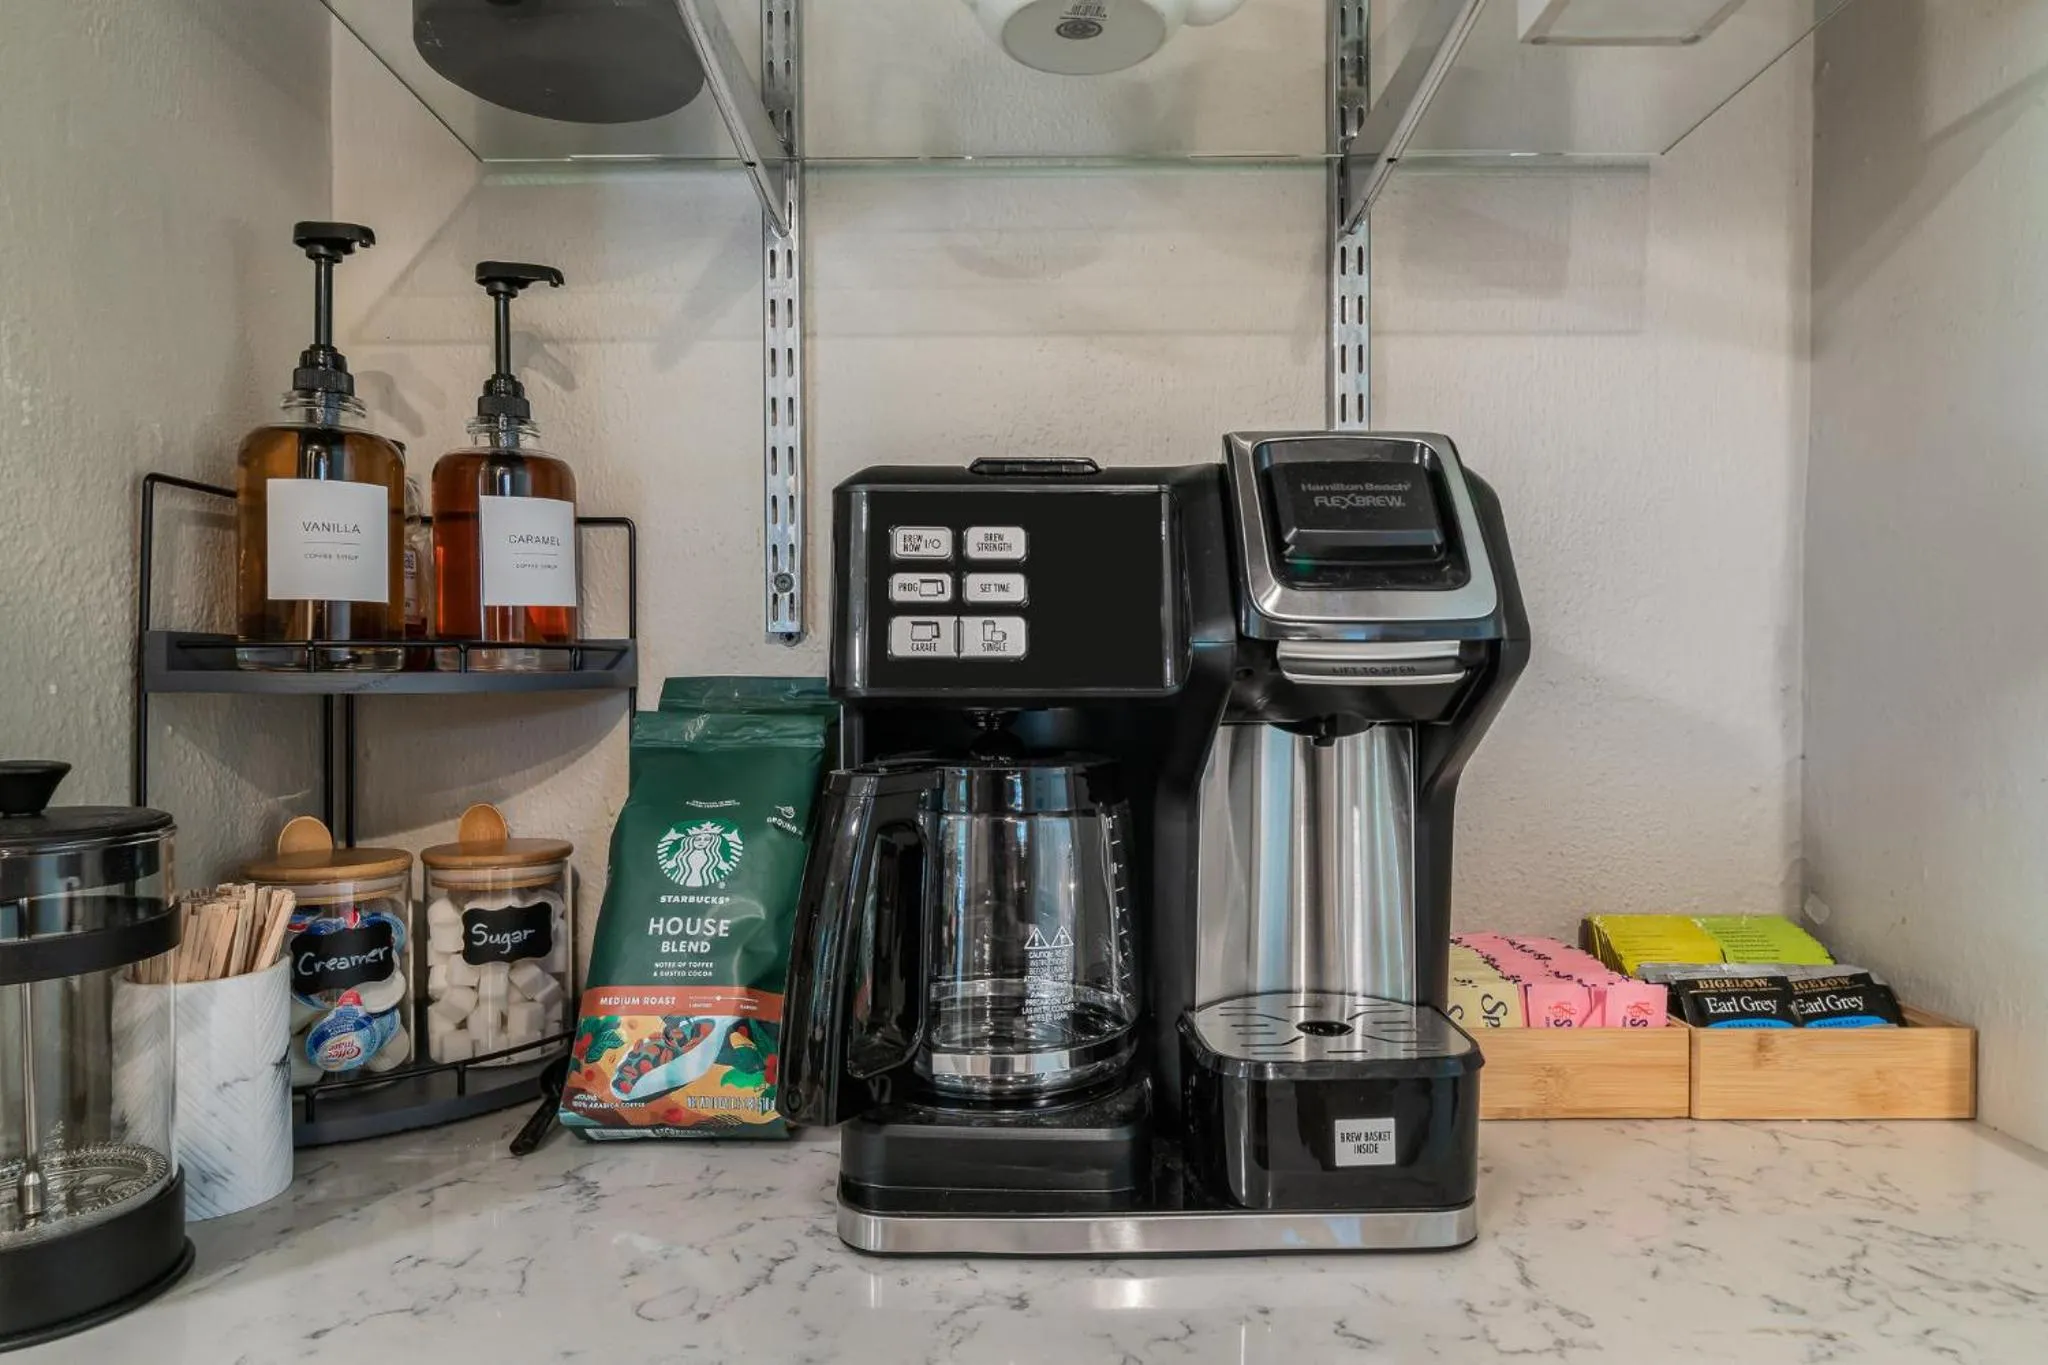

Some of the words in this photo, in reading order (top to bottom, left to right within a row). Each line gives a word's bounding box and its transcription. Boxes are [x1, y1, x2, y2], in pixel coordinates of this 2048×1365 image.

[302, 521, 361, 534] VANILLA
[508, 534, 560, 546] CARAMEL
[903, 534, 923, 543] BREW
[984, 533, 1004, 542] BREW
[903, 544, 921, 552] NOW
[976, 542, 1013, 552] STRENGTH
[898, 583, 918, 592] PROG
[980, 583, 993, 592] SET
[994, 583, 1011, 593] TIME
[911, 643, 937, 652] CARAFE
[981, 643, 1007, 652] SINGLE
[660, 895, 725, 905] STARBUCKS
[648, 916, 732, 937] HOUSE
[471, 922, 536, 954] Sugar
[661, 940, 711, 953] BLEND
[298, 946, 389, 976] Creamer
[1697, 978, 1769, 989] BIGELOW
[600, 996, 640, 1006] MEDIUM
[641, 996, 676, 1006] ROAST
[1704, 996, 1740, 1014] Earl
[1740, 995, 1777, 1014] Grey
[1826, 994, 1864, 1011] Grey
[1340, 1132, 1362, 1143] BREW
[1364, 1131, 1391, 1142] BASKET
[1353, 1143, 1379, 1154] INSIDE
